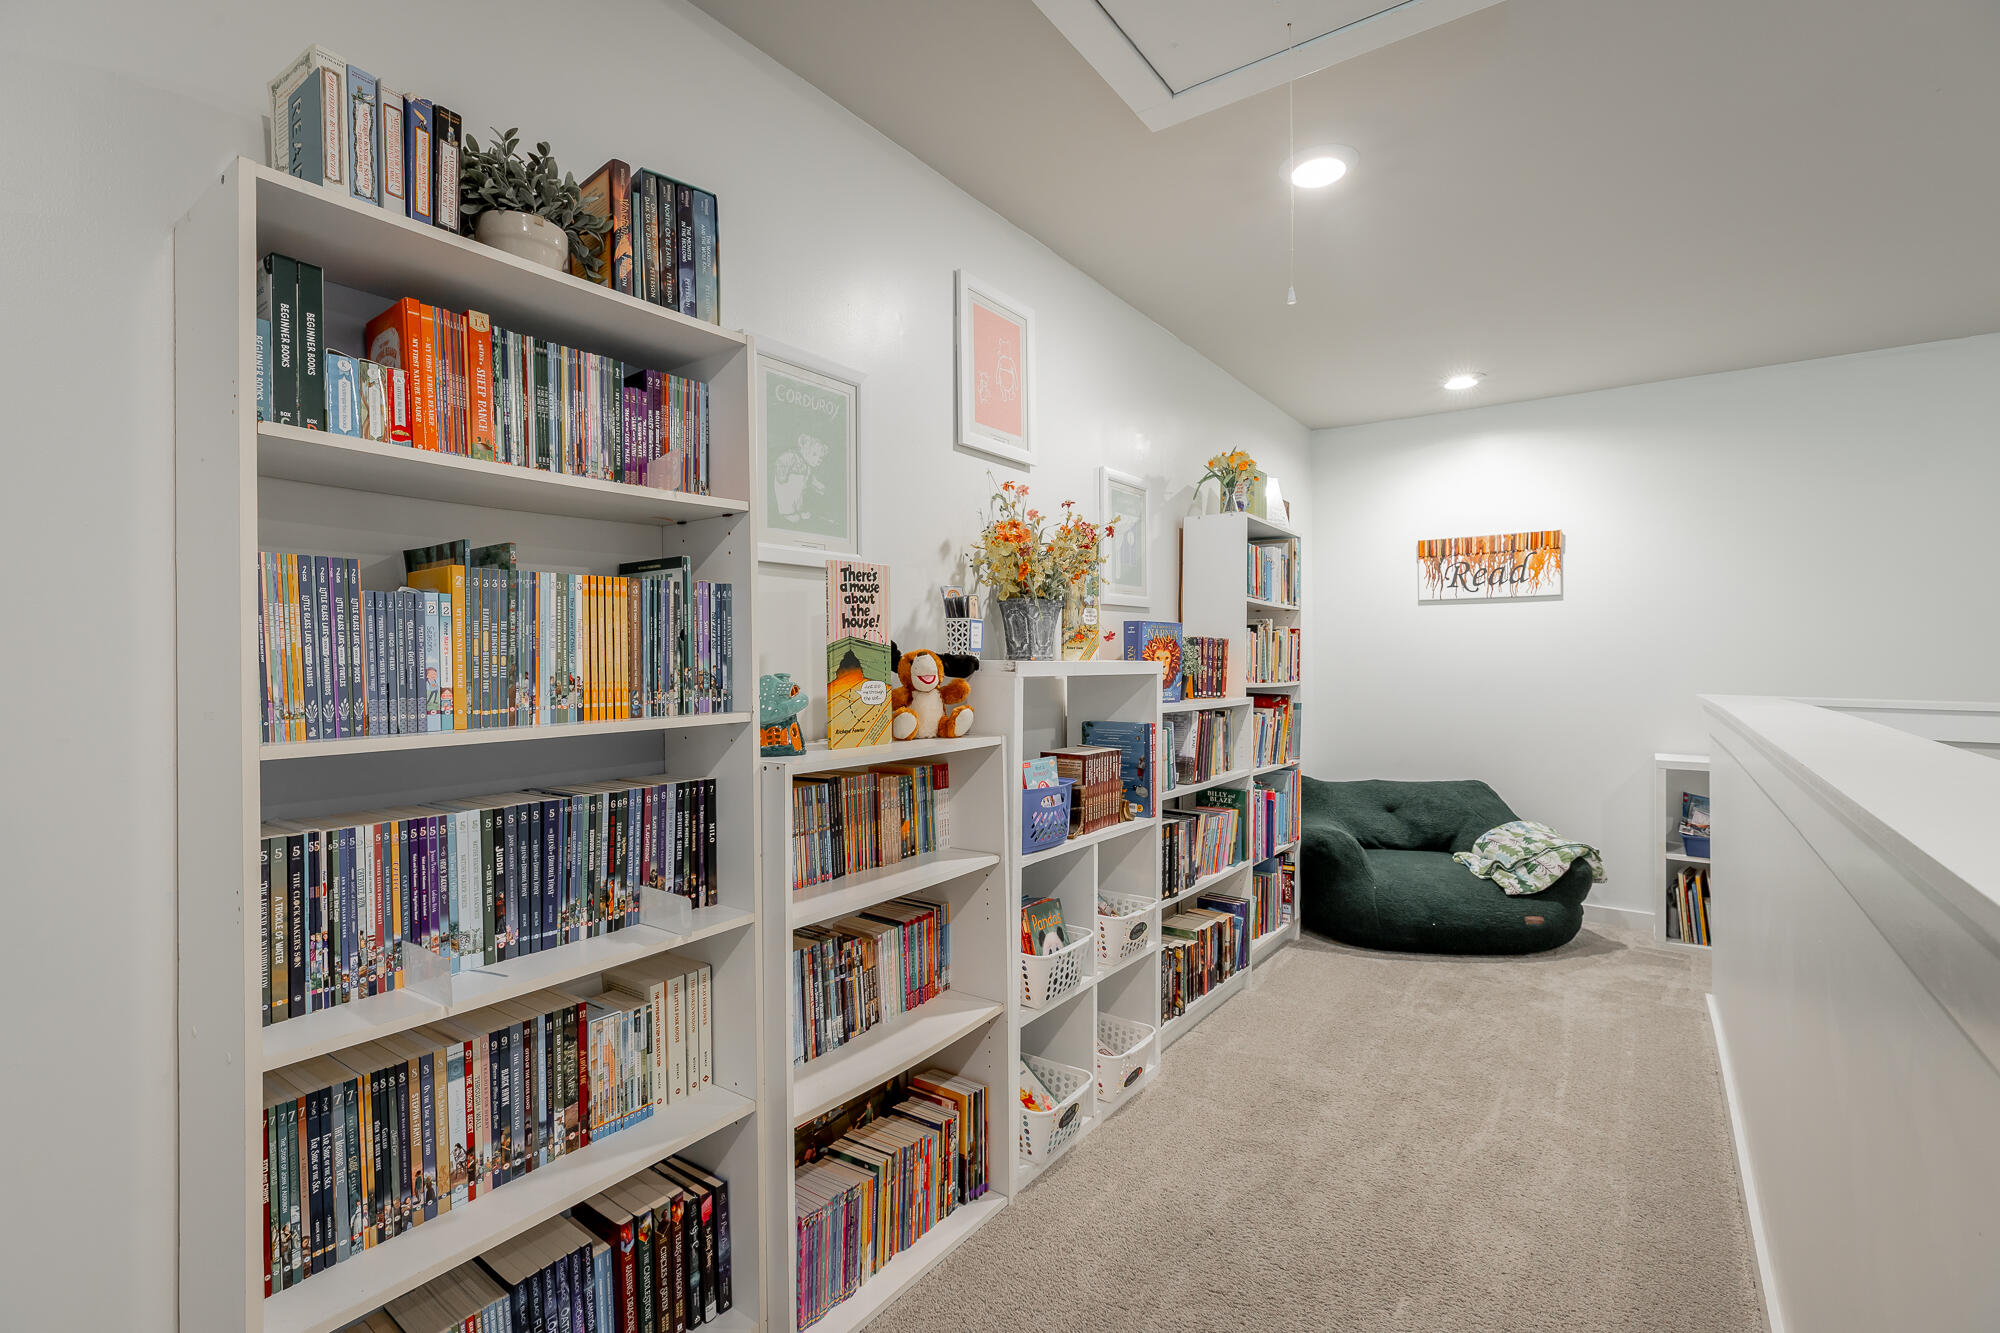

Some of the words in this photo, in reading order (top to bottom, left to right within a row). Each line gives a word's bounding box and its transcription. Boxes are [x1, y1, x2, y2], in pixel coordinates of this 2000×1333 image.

[281, 303, 290, 343] BEGINNER
[306, 312, 316, 352] BEGINNER
[281, 345, 291, 368] BOOKS
[306, 353, 317, 376] BOOKS
[476, 367, 487, 397] SHEEP
[414, 396, 422, 423] READER
[775, 384, 840, 422] CORDUROY
[427, 399, 435, 426] READER
[477, 400, 488, 432] RANCH
[840, 565, 878, 583] There's
[1445, 551, 1538, 593] Read
[319, 587, 328, 603] LITTLE
[849, 580, 880, 593] mouse
[301, 595, 311, 611] LITTLE
[335, 597, 345, 613] LITTLE
[351, 598, 360, 613] LITTLE
[844, 593, 876, 605] about
[320, 605, 329, 621] GLASS
[850, 604, 871, 617] the
[302, 613, 311, 629] GLASS
[321, 622, 330, 636] LAKE
[337, 615, 345, 630] GLASS
[352, 615, 360, 631] GLASS
[842, 613, 880, 629] house!
[303, 630, 312, 644] LAKE
[338, 632, 346, 645] LAKE
[305, 666, 314, 687] RABBITS
[339, 666, 347, 687] TURTLES
[353, 666, 361, 683] DUCKS
[1207, 790, 1227, 798] BILLY
[1209, 796, 1233, 804] BLAZE
[292, 846, 302, 857] 5
[495, 846, 504, 875] JUDDIE
[292, 871, 300, 888] THE
[261, 881, 269, 896] THE
[261, 898, 269, 924] LEGEND
[292, 890, 301, 916] CLOCK
[274, 903, 284, 930] TRICKLE
[1031, 910, 1062, 934] Pandas
[262, 926, 270, 937] OF
[275, 931, 284, 940] OF
[293, 917, 301, 951] MAKER'S
[275, 941, 284, 965] WATER
[293, 952, 302, 968] SON
[335, 1124, 344, 1137] THE
[413, 1123, 421, 1147] FAMILY
[311, 1149, 319, 1163] SIDE
[322, 1145, 331, 1159] SIDE
[324, 1177, 332, 1190] SEA
[336, 1168, 346, 1183] TREE
[312, 1181, 320, 1193] SEA
[674, 1232, 682, 1256] TEARS
[626, 1264, 634, 1295] RAISING
[675, 1267, 683, 1299] DRAGON
[643, 1265, 652, 1321] CANDLESTONE
[660, 1287, 669, 1311] SEVEN
[626, 1296, 634, 1333] DRAGONS
